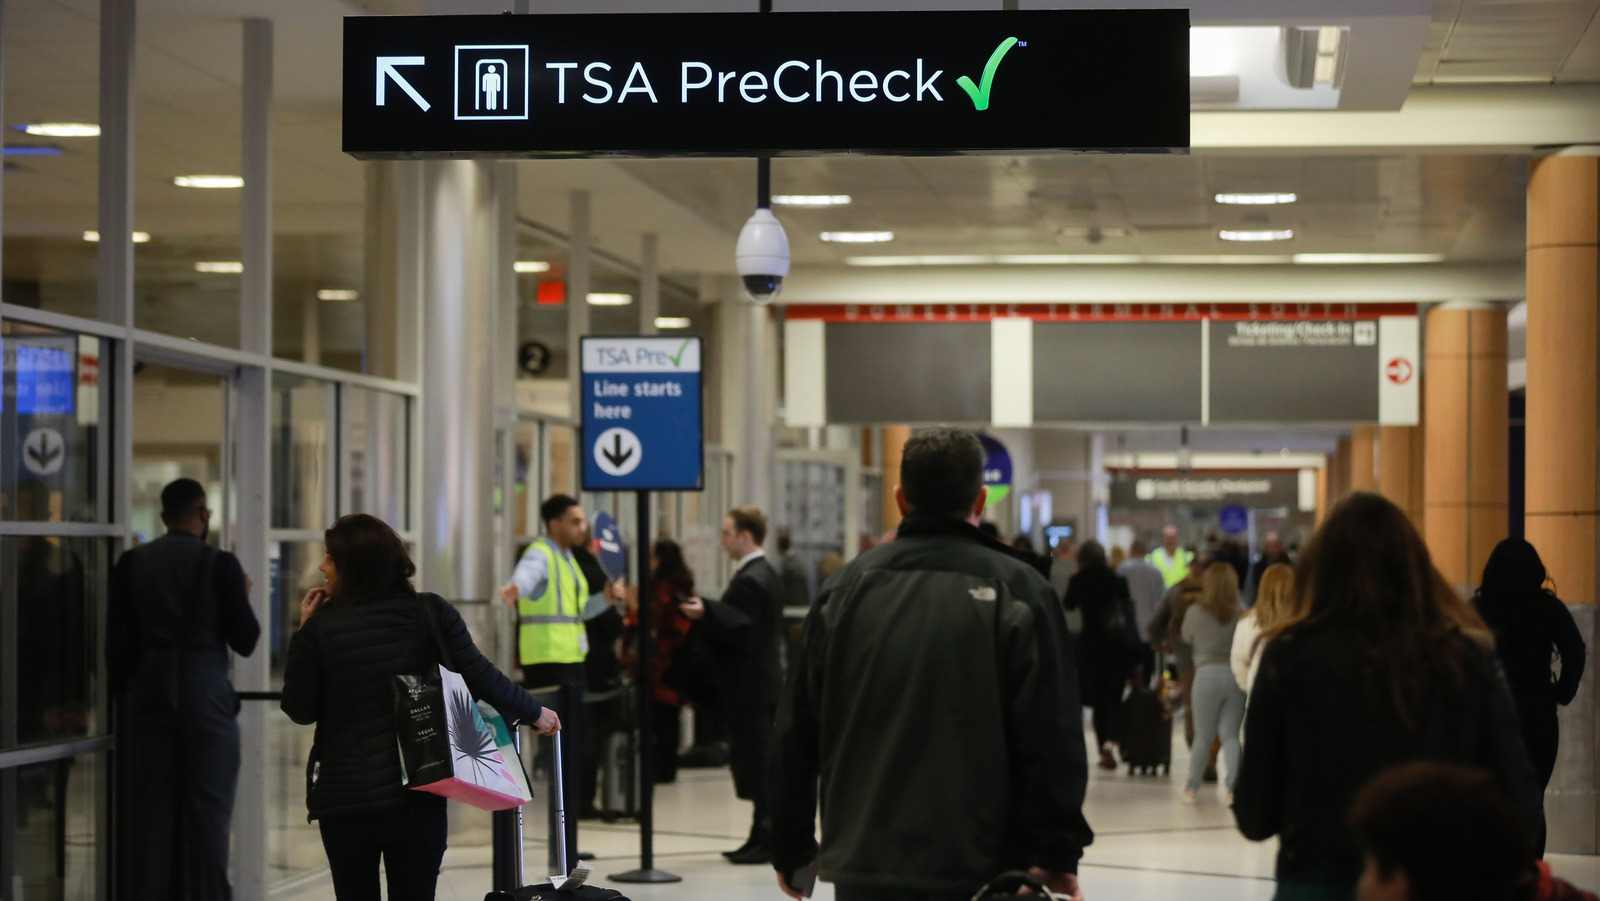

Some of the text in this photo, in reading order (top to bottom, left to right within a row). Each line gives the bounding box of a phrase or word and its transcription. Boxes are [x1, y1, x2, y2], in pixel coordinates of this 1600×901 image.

[545, 61, 658, 104] TSA
[681, 58, 944, 104] PreCheck
[844, 303, 1358, 319] DOMESTIC TERMINAL SOUTH
[595, 347, 667, 366] TSA Pre
[593, 380, 682, 397] Line starts
[593, 401, 632, 419] here
[410, 705, 430, 714] DALLAS
